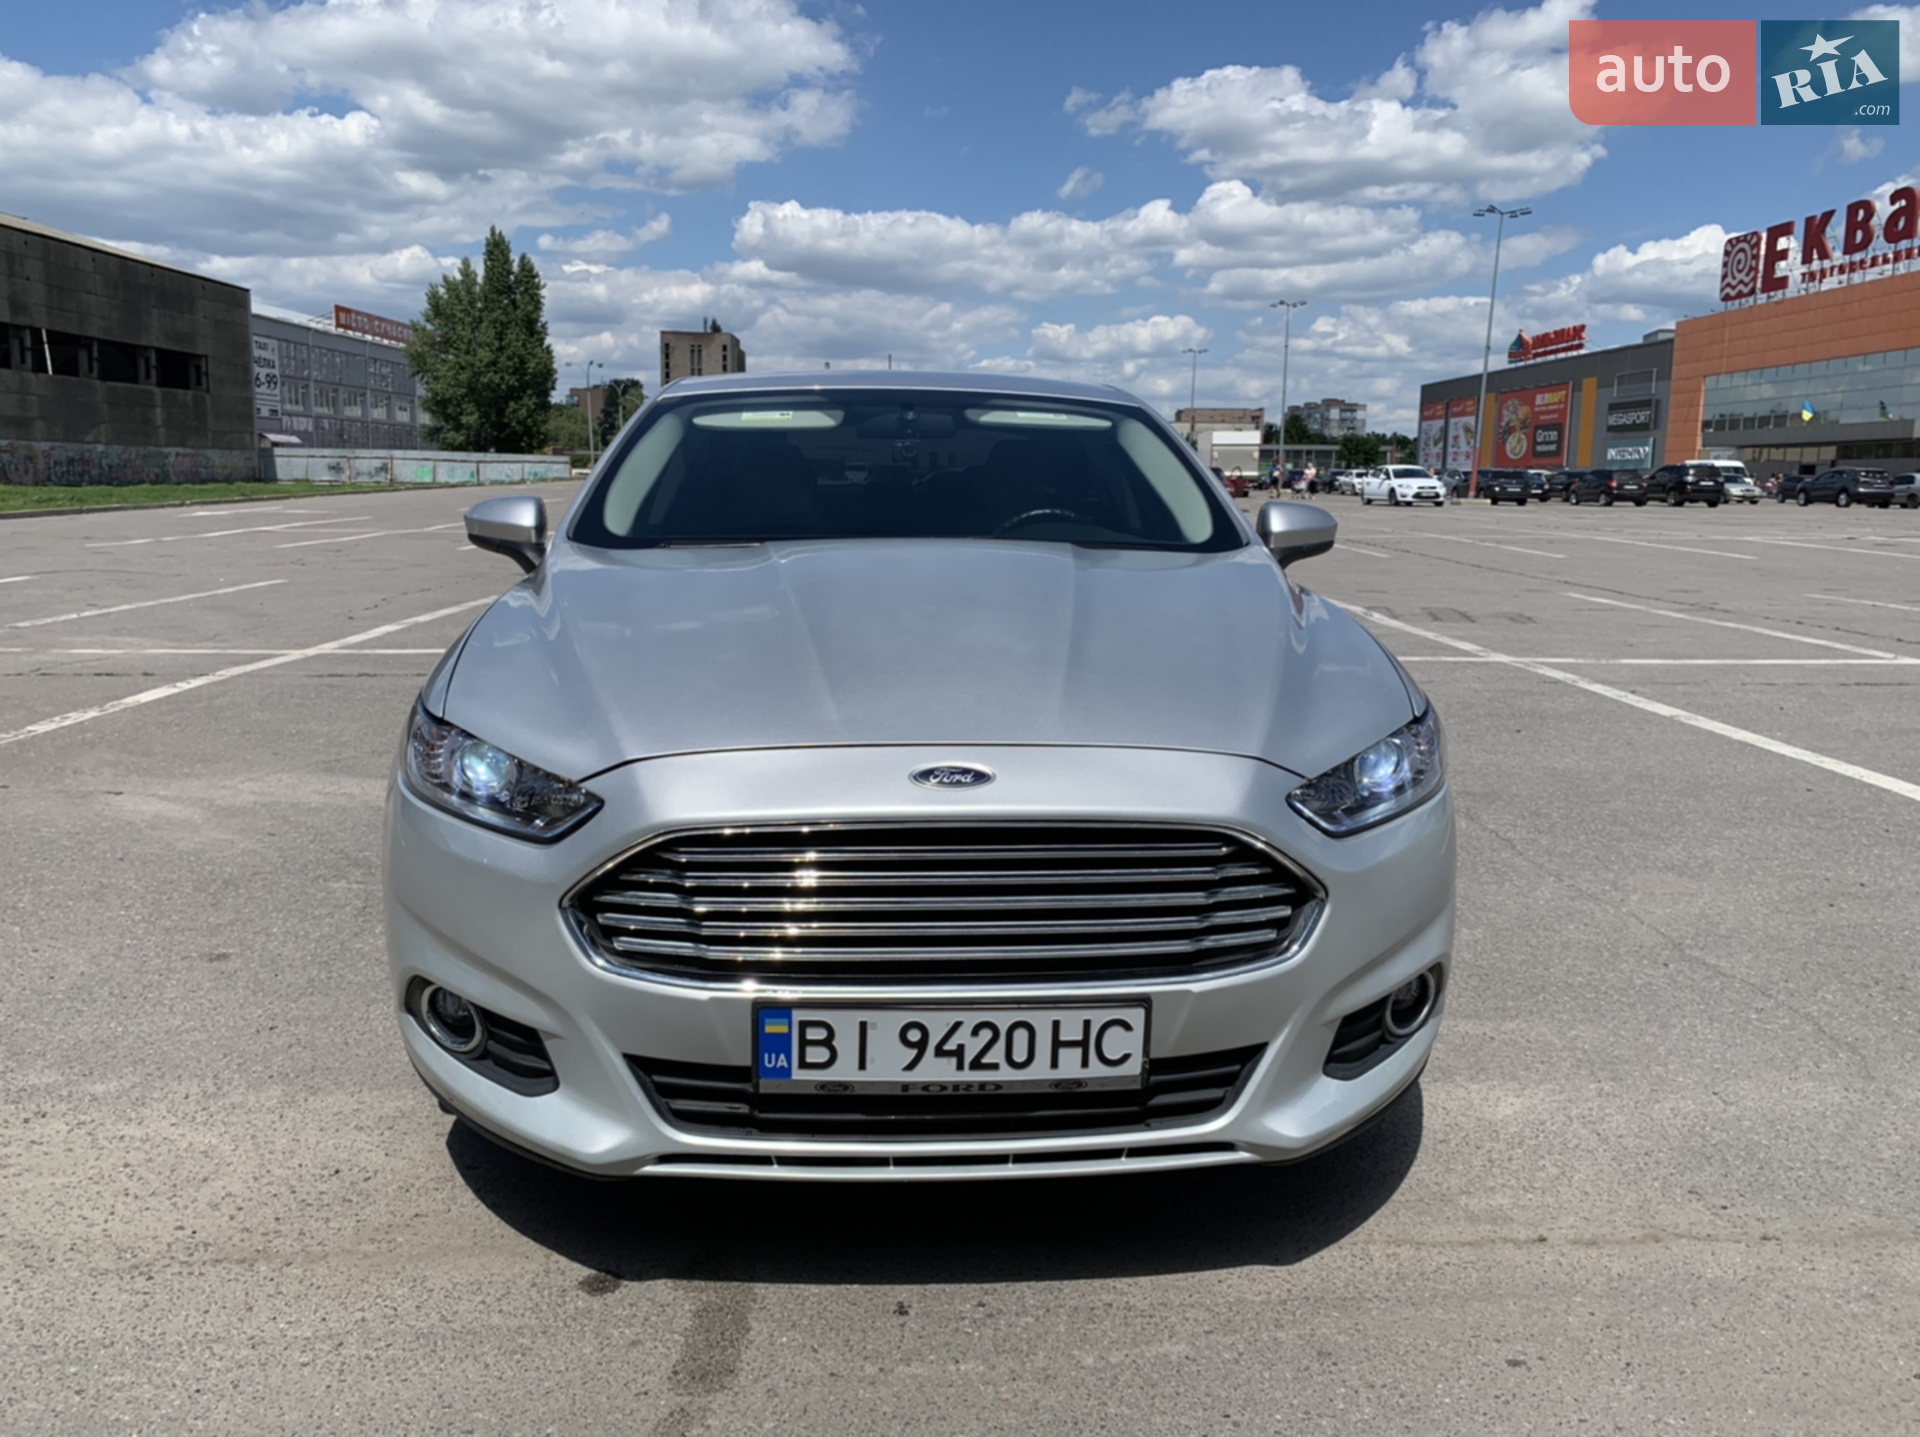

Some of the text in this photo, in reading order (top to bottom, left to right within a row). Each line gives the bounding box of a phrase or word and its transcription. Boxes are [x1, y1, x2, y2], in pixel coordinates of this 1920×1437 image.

[1607, 410, 1651, 426] MEGASPORT
[928, 768, 976, 784] Ford
[898, 1020, 1037, 1072] 9420
[1050, 1018, 1134, 1070] HC
[763, 1053, 789, 1069] UA
[901, 1083, 1004, 1093] FORD
